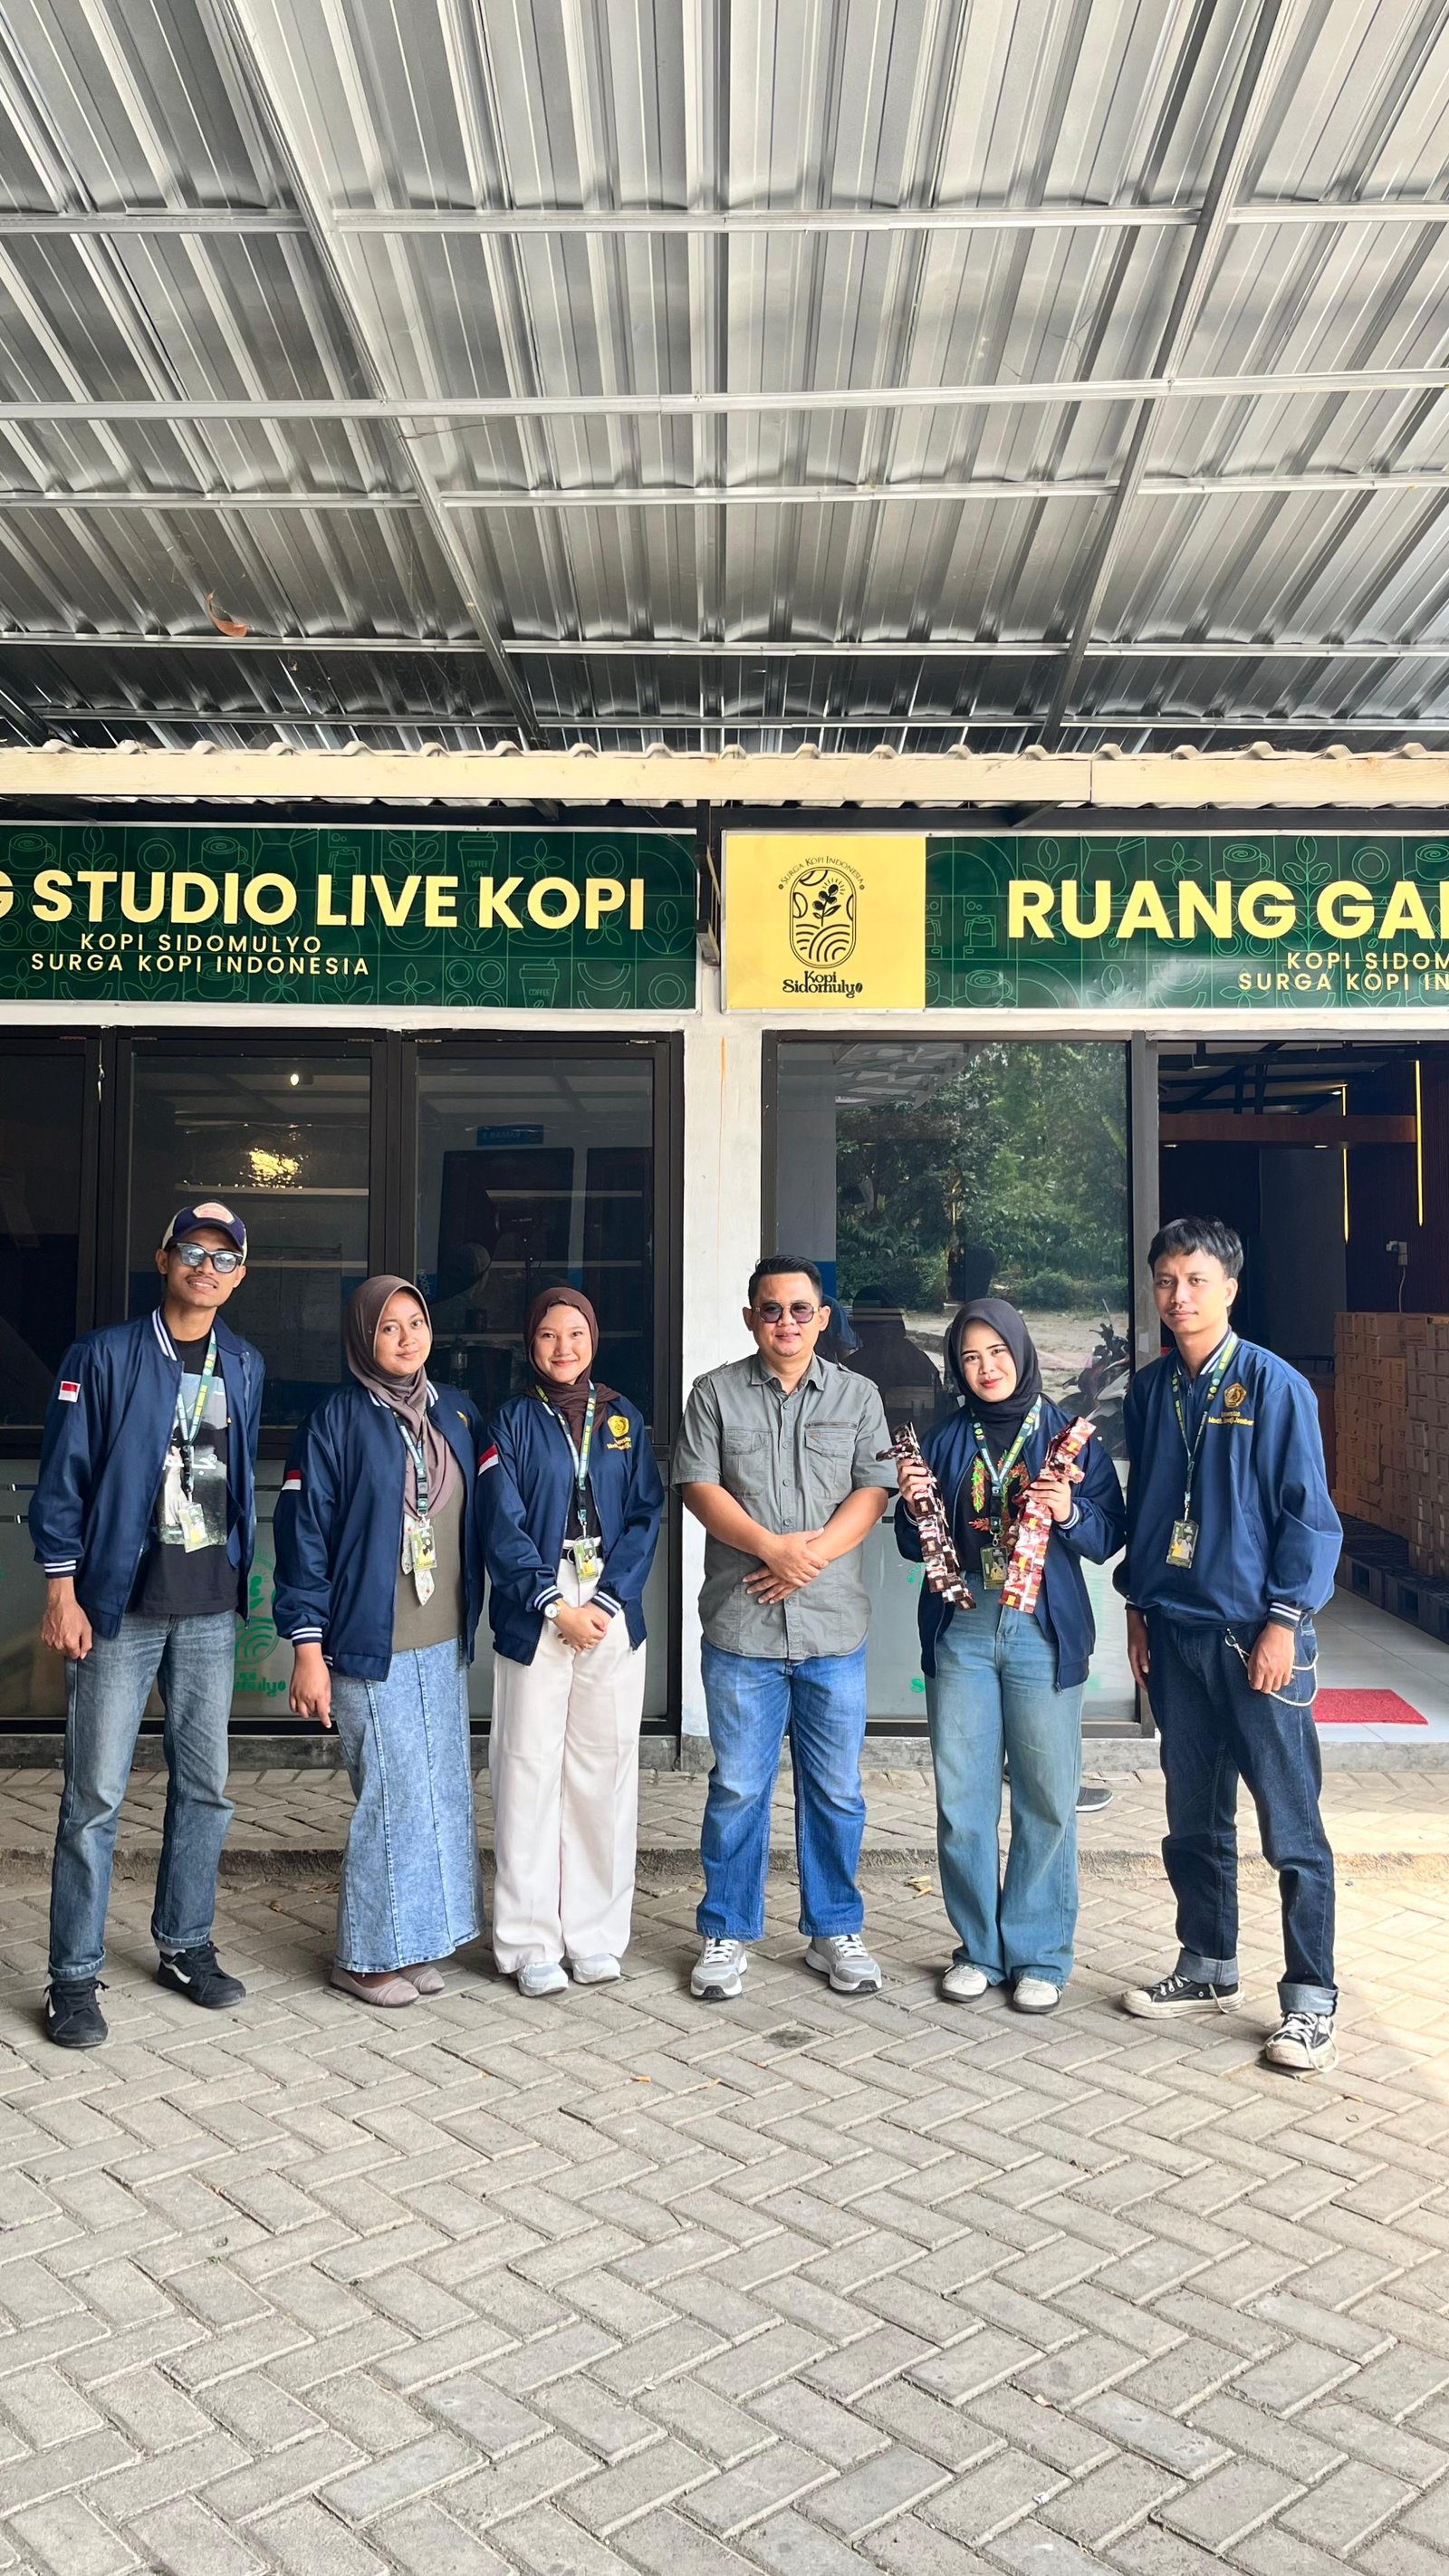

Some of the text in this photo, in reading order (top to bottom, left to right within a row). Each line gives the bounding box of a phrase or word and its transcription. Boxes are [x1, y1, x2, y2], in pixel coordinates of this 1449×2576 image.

[781, 863, 805, 885] SURGA
[826, 855, 864, 884] INDONESIA
[32, 870, 297, 926] STUDIO
[316, 874, 458, 928] LIVE
[478, 876, 644, 930] KOPI
[1008, 879, 1449, 939] RUANG GA
[81, 933, 321, 954] KOPI SIDOMULYO
[31, 953, 369, 976] SURGA KOPI INDONESIA
[1287, 952, 1449, 970] KOPI SIDOM
[804, 970, 837, 985] Kopi
[1238, 972, 1449, 991] SURGA KOPI IN
